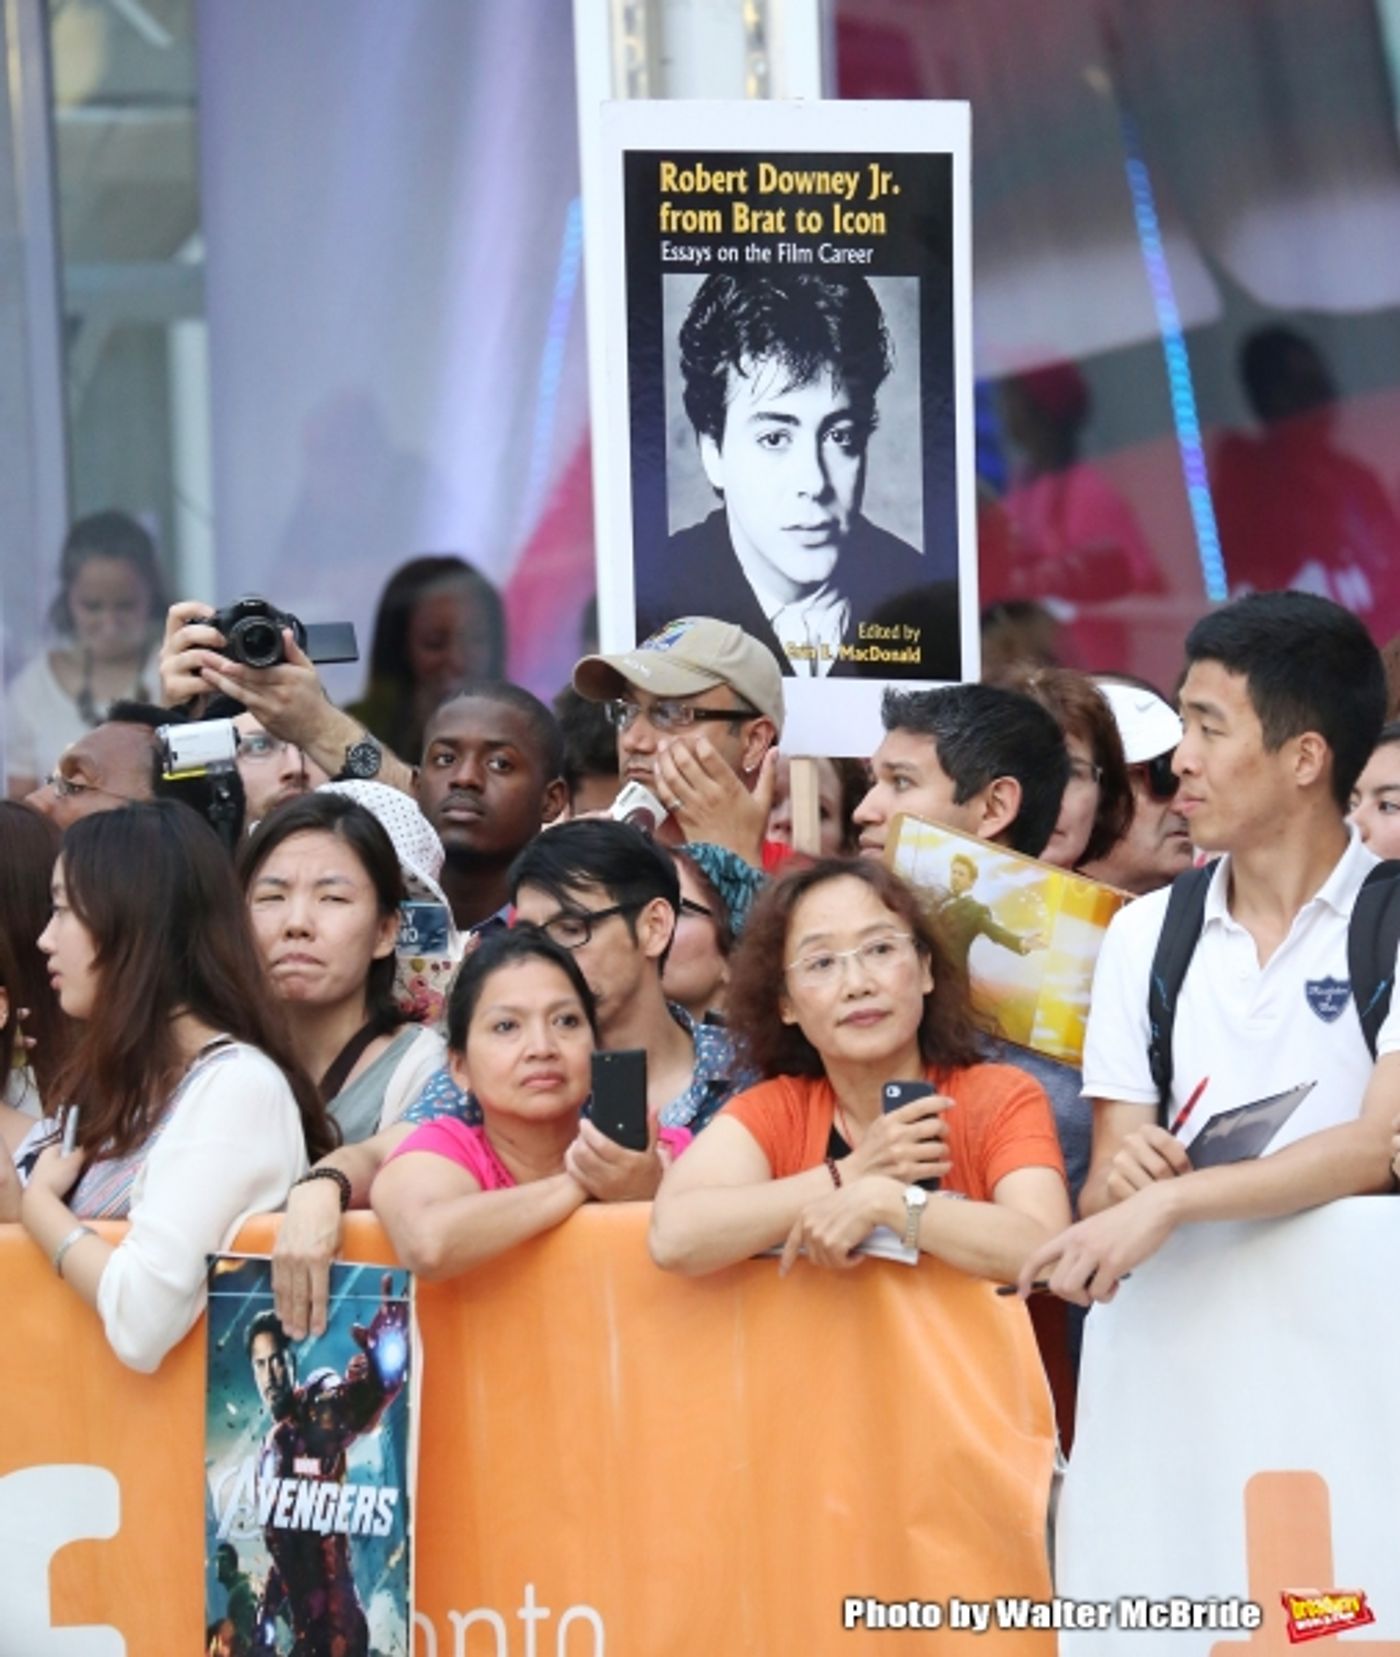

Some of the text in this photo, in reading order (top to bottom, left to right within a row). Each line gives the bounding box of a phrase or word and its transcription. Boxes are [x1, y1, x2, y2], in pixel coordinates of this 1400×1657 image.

[659, 161, 900, 200] Robert Downey Jr.
[659, 202, 887, 234] from Brat to Icon
[660, 241, 874, 264] Essays on the Film Career
[858, 622, 921, 642] Edited by
[838, 644, 922, 663] MacDonald
[213, 1456, 400, 1540] AVENGERS
